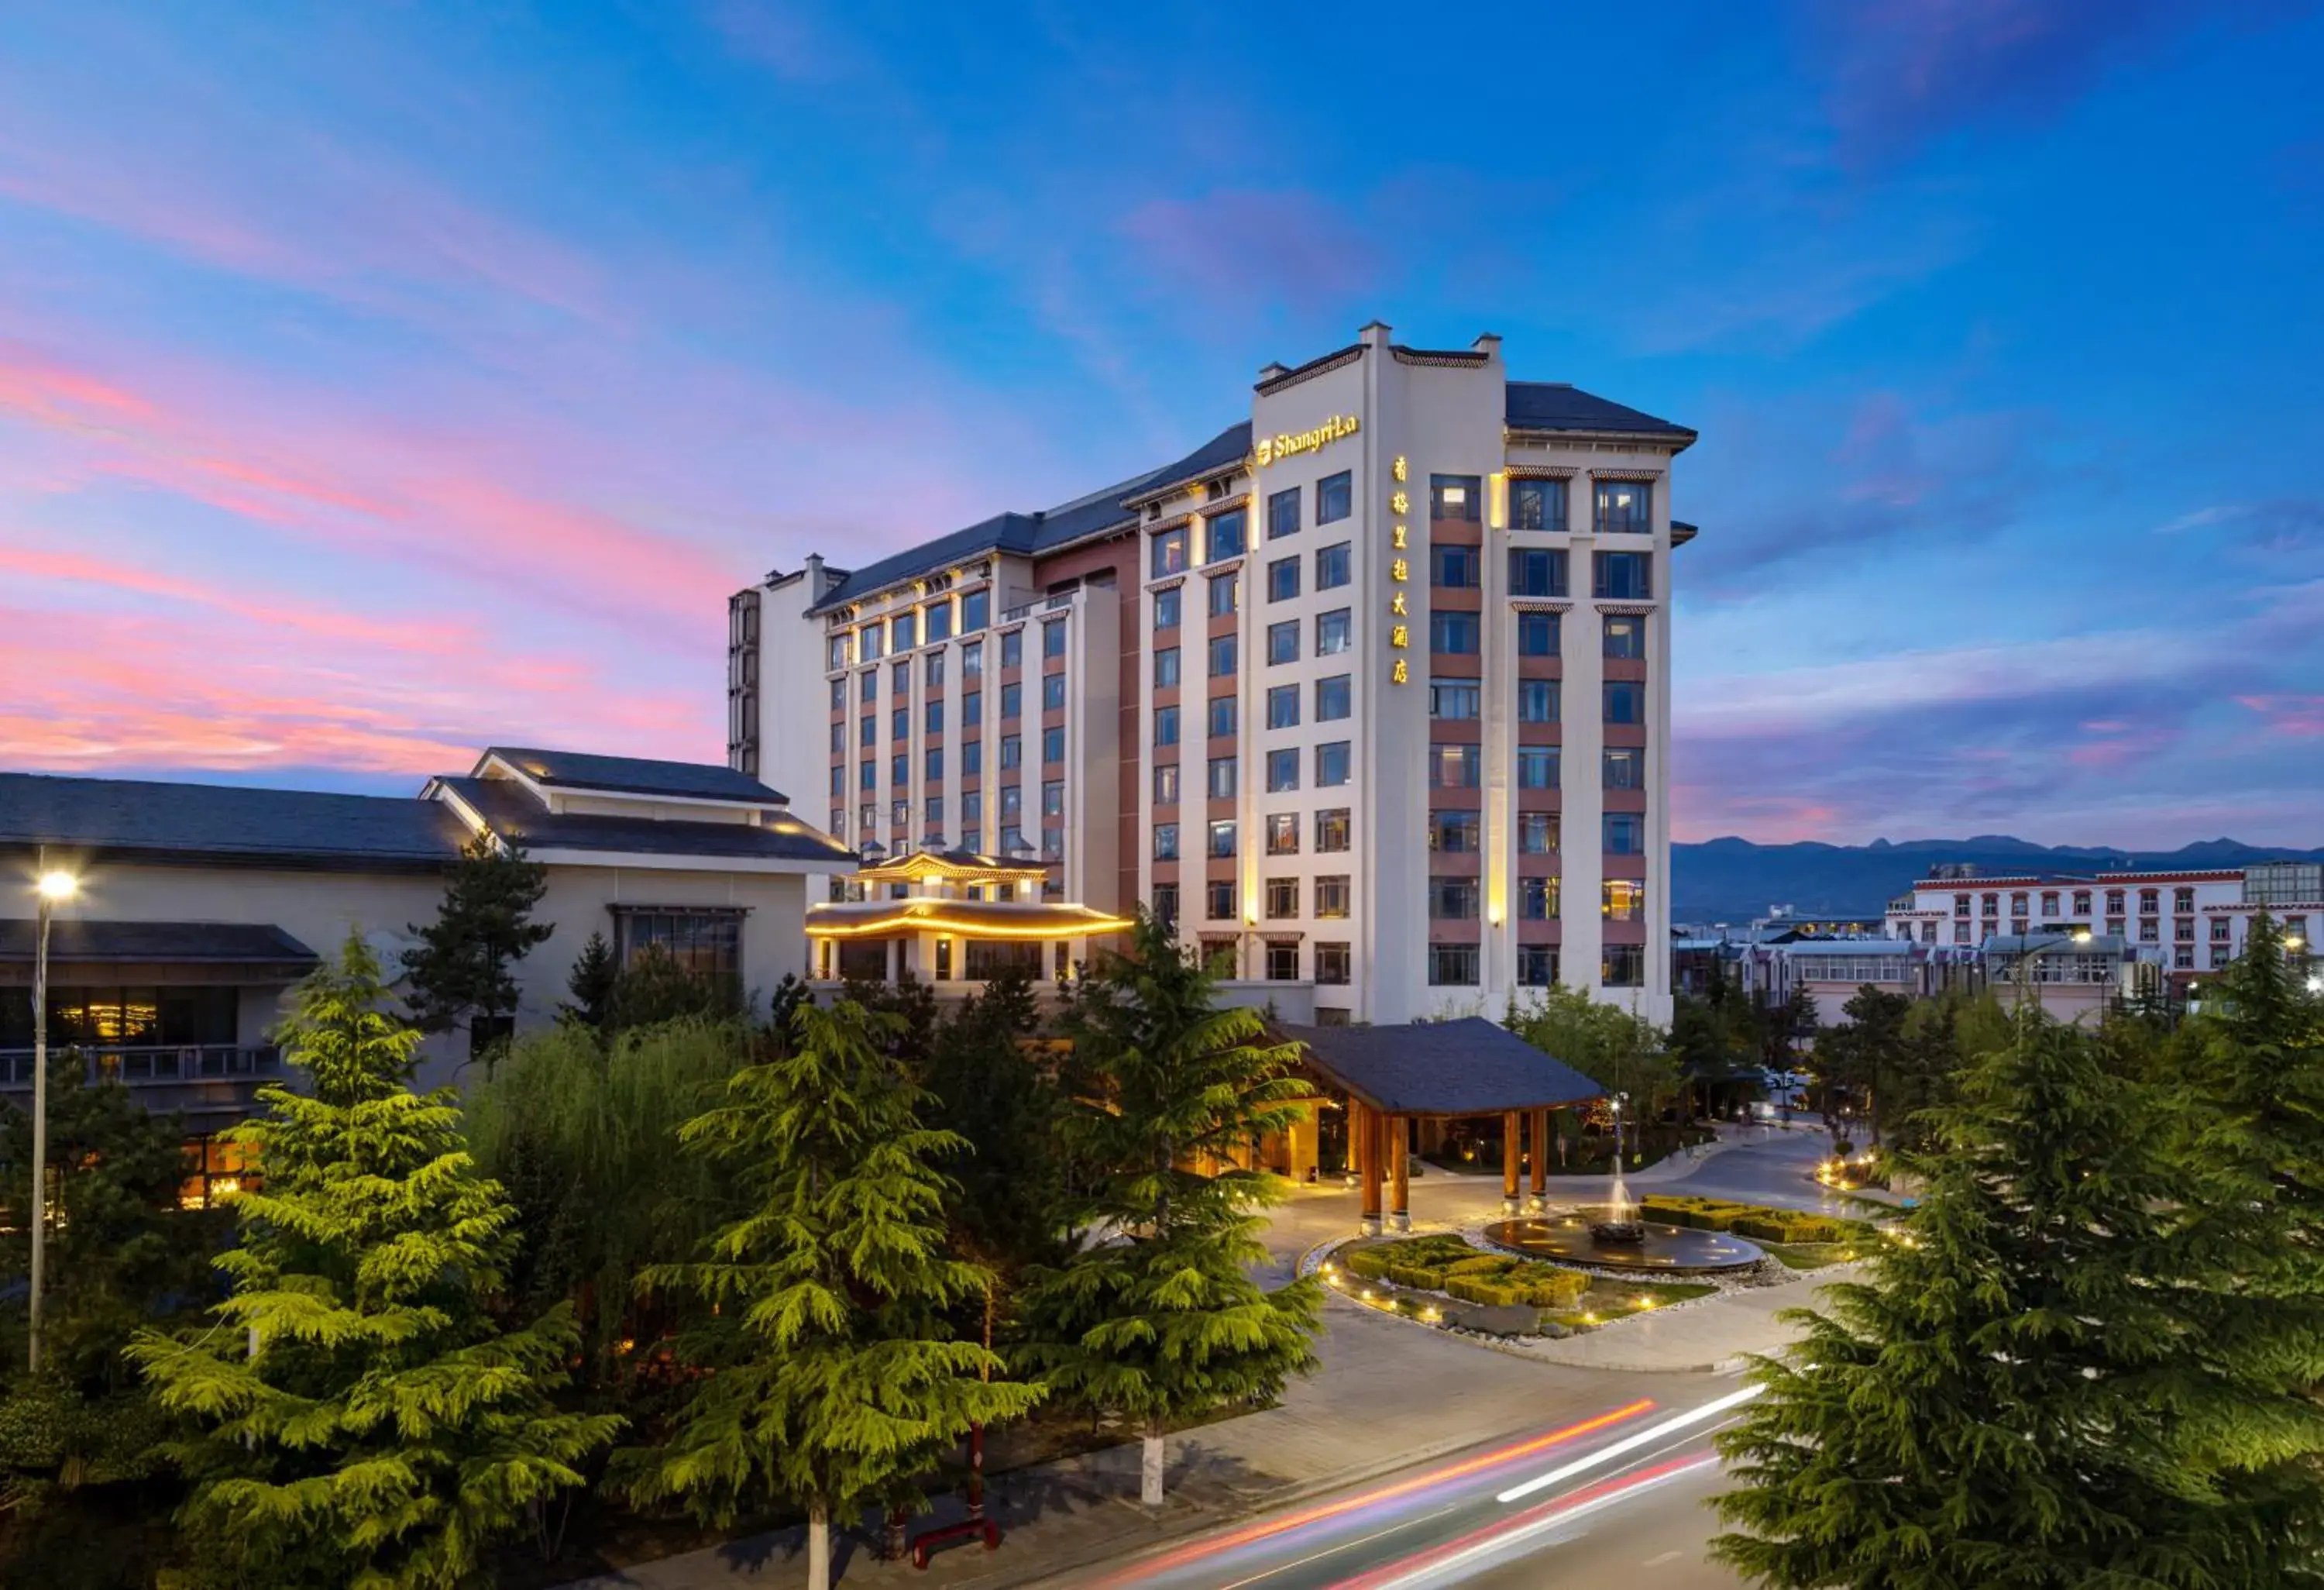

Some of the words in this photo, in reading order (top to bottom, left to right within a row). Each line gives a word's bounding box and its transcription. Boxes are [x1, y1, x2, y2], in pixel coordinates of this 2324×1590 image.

[1274, 415, 1358, 457] Shangri-La
[1392, 455, 1409, 683] 香格里拉大酒店
